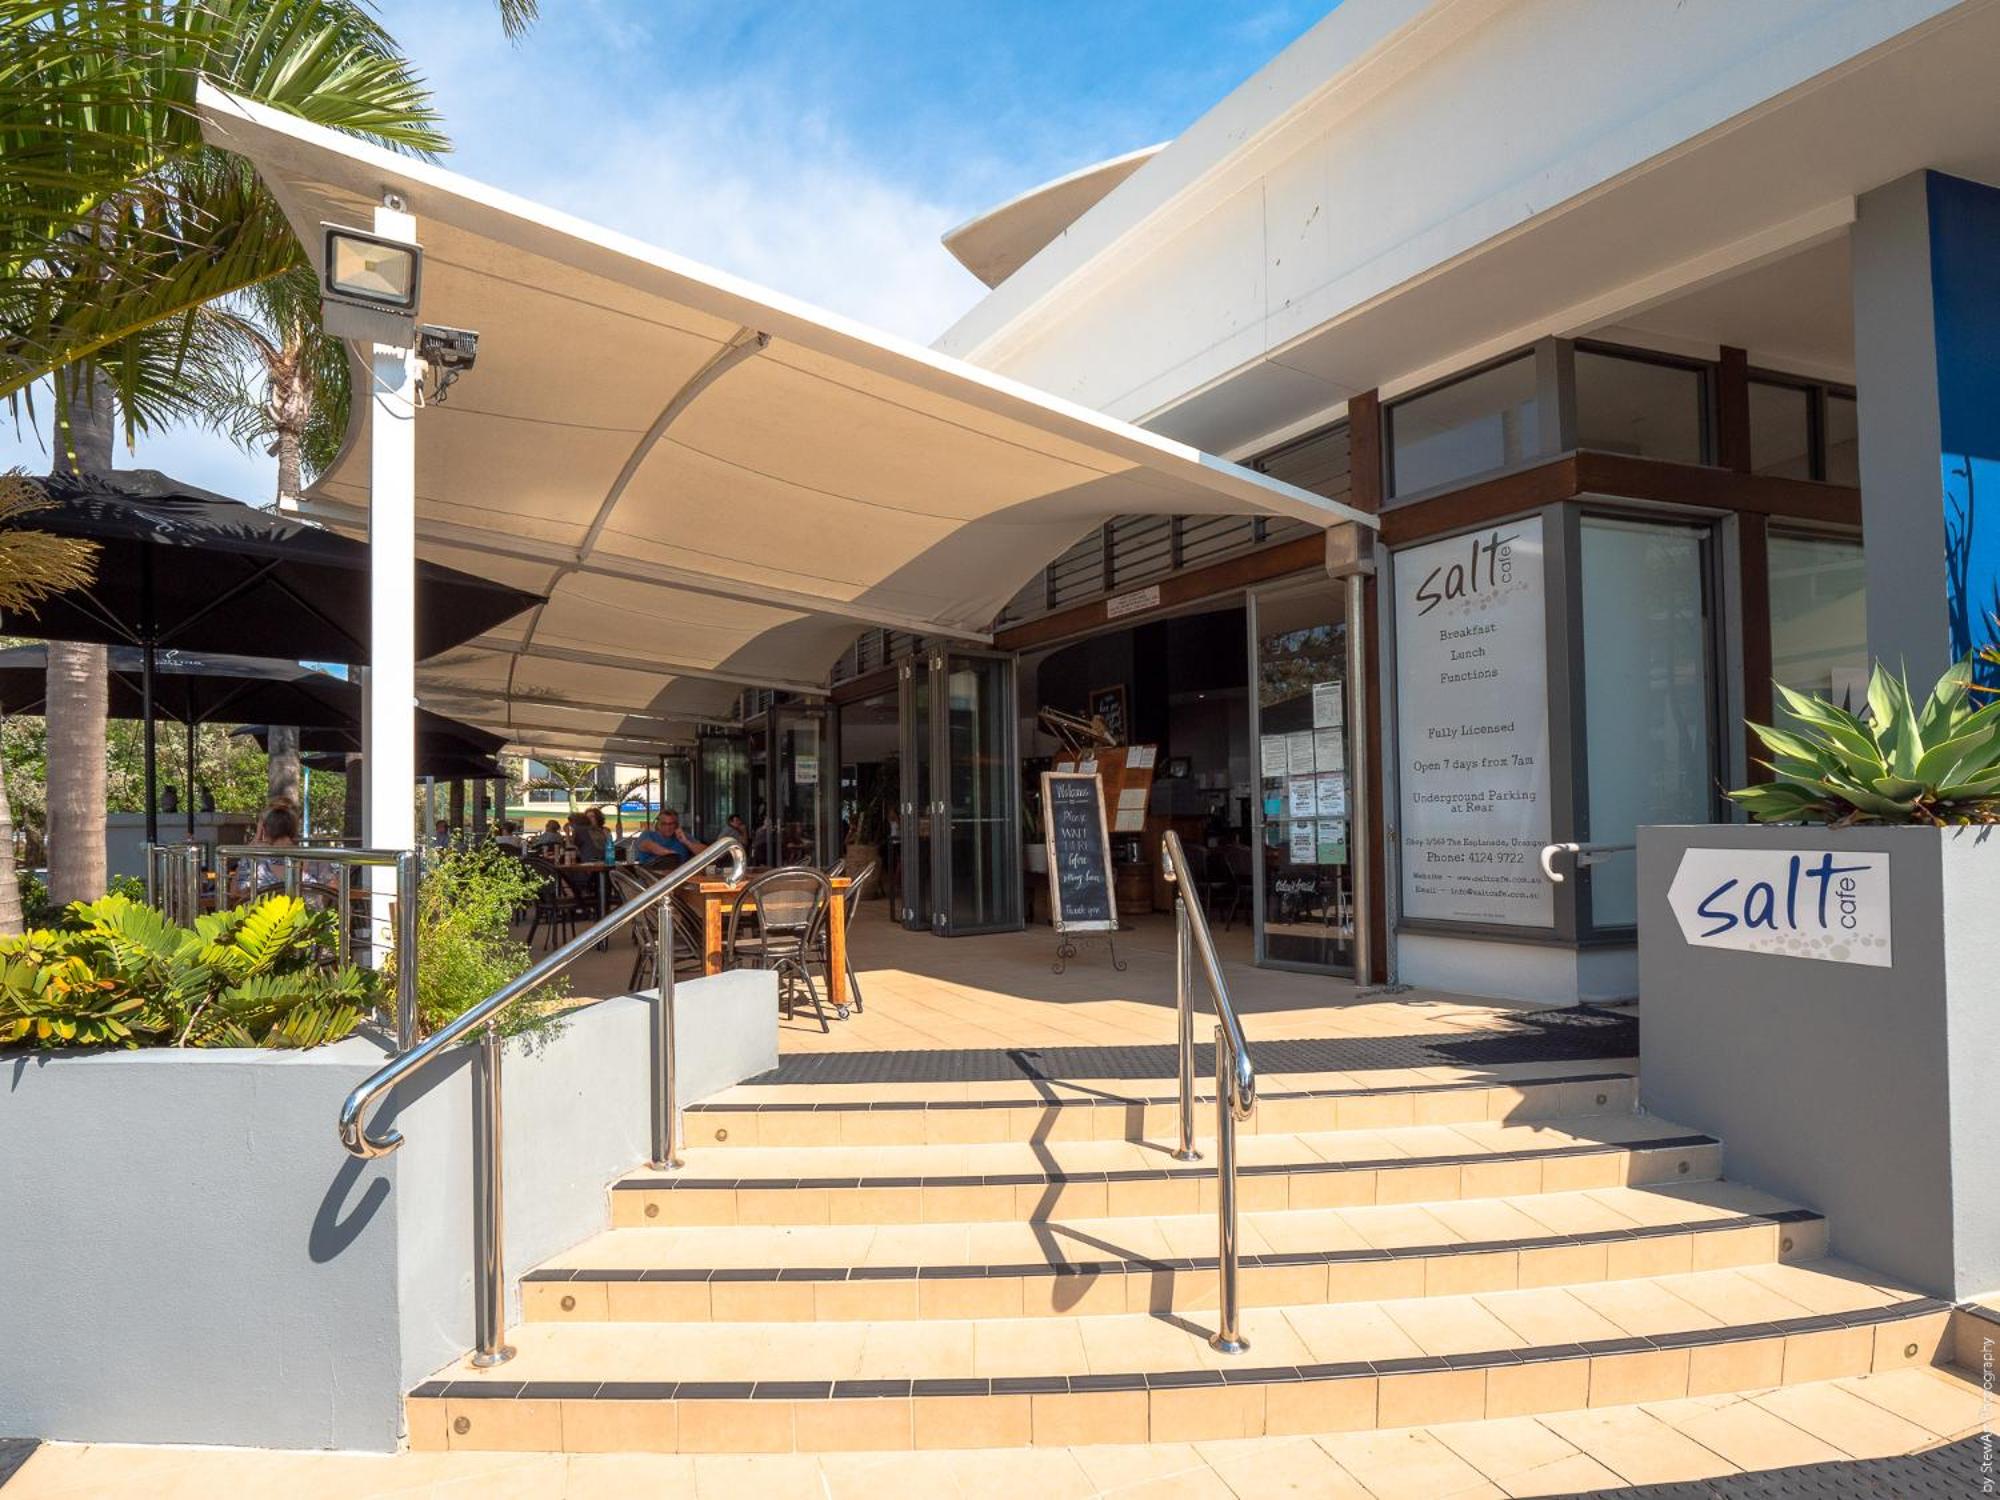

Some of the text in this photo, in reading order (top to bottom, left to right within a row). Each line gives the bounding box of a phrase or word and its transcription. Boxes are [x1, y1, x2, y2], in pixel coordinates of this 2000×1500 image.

[1498, 545, 1512, 583] cafe
[1416, 531, 1521, 616] salt
[1439, 623, 1498, 641] Breakfast
[1450, 647, 1486, 661] Lunch
[1440, 667, 1499, 684] Functions
[1428, 722, 1515, 739] Fully Licensed
[1413, 754, 1534, 773] Open 7 days from 7am
[1412, 790, 1536, 804] Underground Parking
[1451, 802, 1494, 813] at Rear
[1427, 852, 1524, 863] Phone: 4124 9722
[1697, 853, 1872, 937] salt
[1836, 877, 1856, 929] cafe
